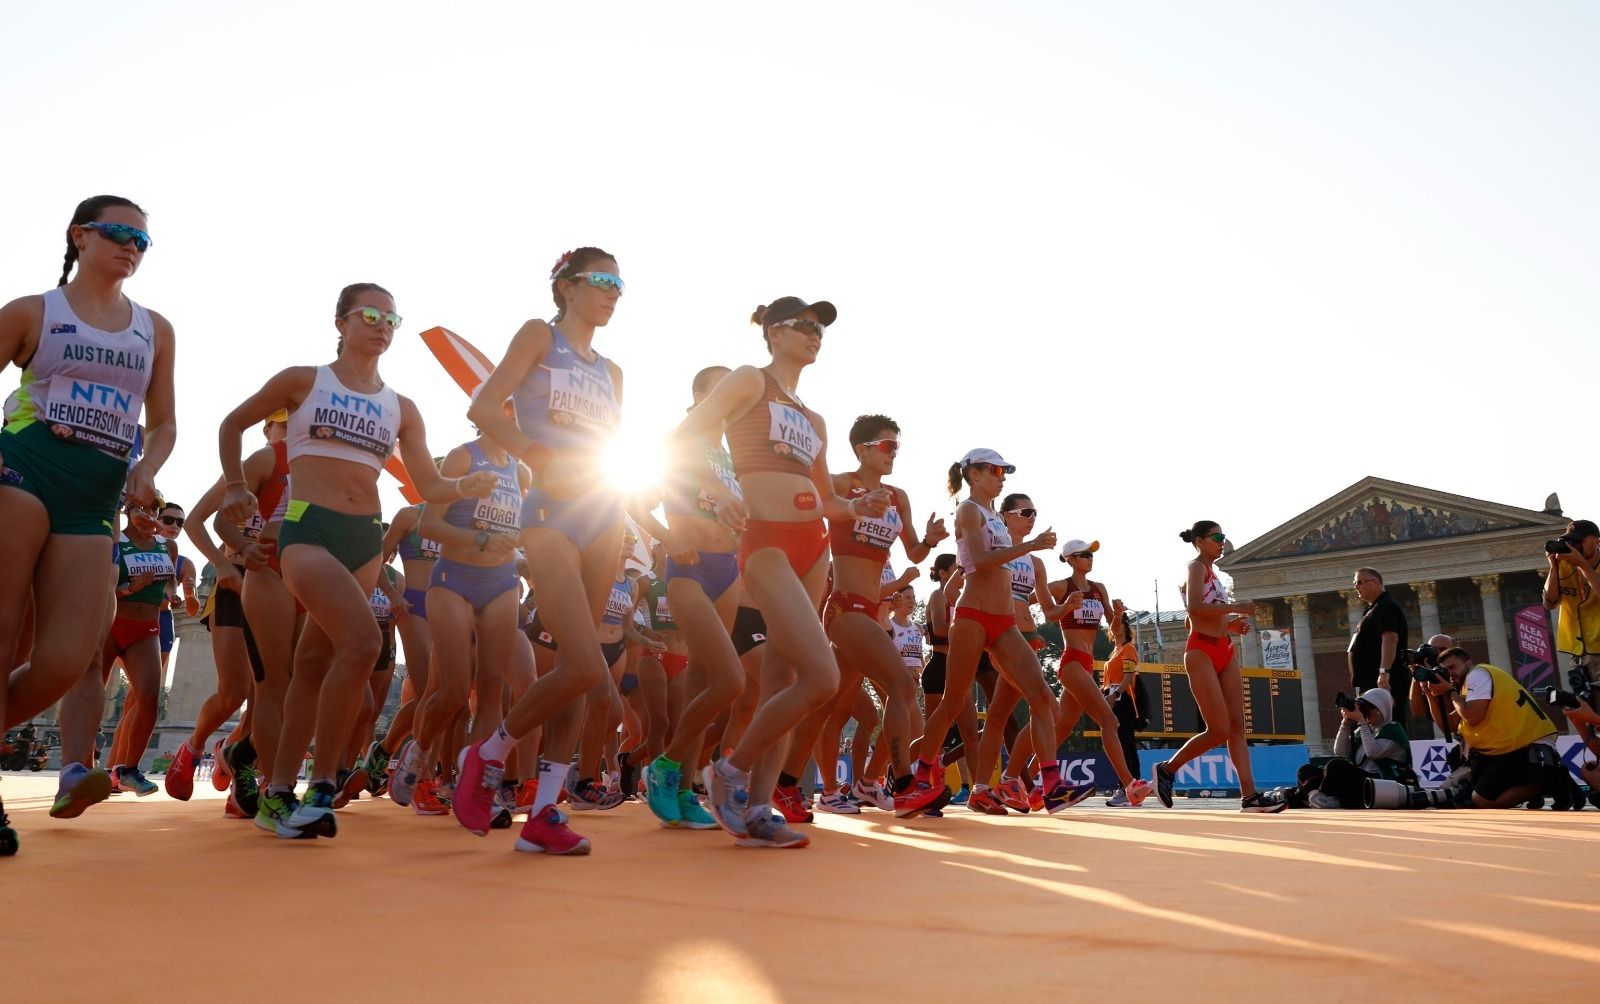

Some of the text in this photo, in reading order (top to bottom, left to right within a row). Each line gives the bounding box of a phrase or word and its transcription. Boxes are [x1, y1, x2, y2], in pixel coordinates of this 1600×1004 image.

[63, 344, 145, 373] AUSTRALIA
[70, 381, 132, 415] NTN
[568, 372, 615, 413] NTN
[330, 391, 382, 418] NTN
[49, 402, 135, 440] HENDERSON 100
[314, 407, 391, 441] MONTAG 101
[75, 430, 121, 451] BUDAPEST
[335, 430, 376, 449] BUDAPEST
[779, 423, 813, 453] YANG
[491, 490, 521, 507] NTN
[477, 504, 516, 526] GIORGI
[857, 520, 893, 539] PÉREZ
[134, 554, 164, 563] NTN
[130, 564, 164, 575] ORTUÑO
[1082, 610, 1094, 619] MA
[1519, 623, 1543, 639] ALEA
[1520, 632, 1547, 649] IACTA
[1521, 641, 1545, 656] EST?
[1271, 670, 1297, 678] SEIKO
